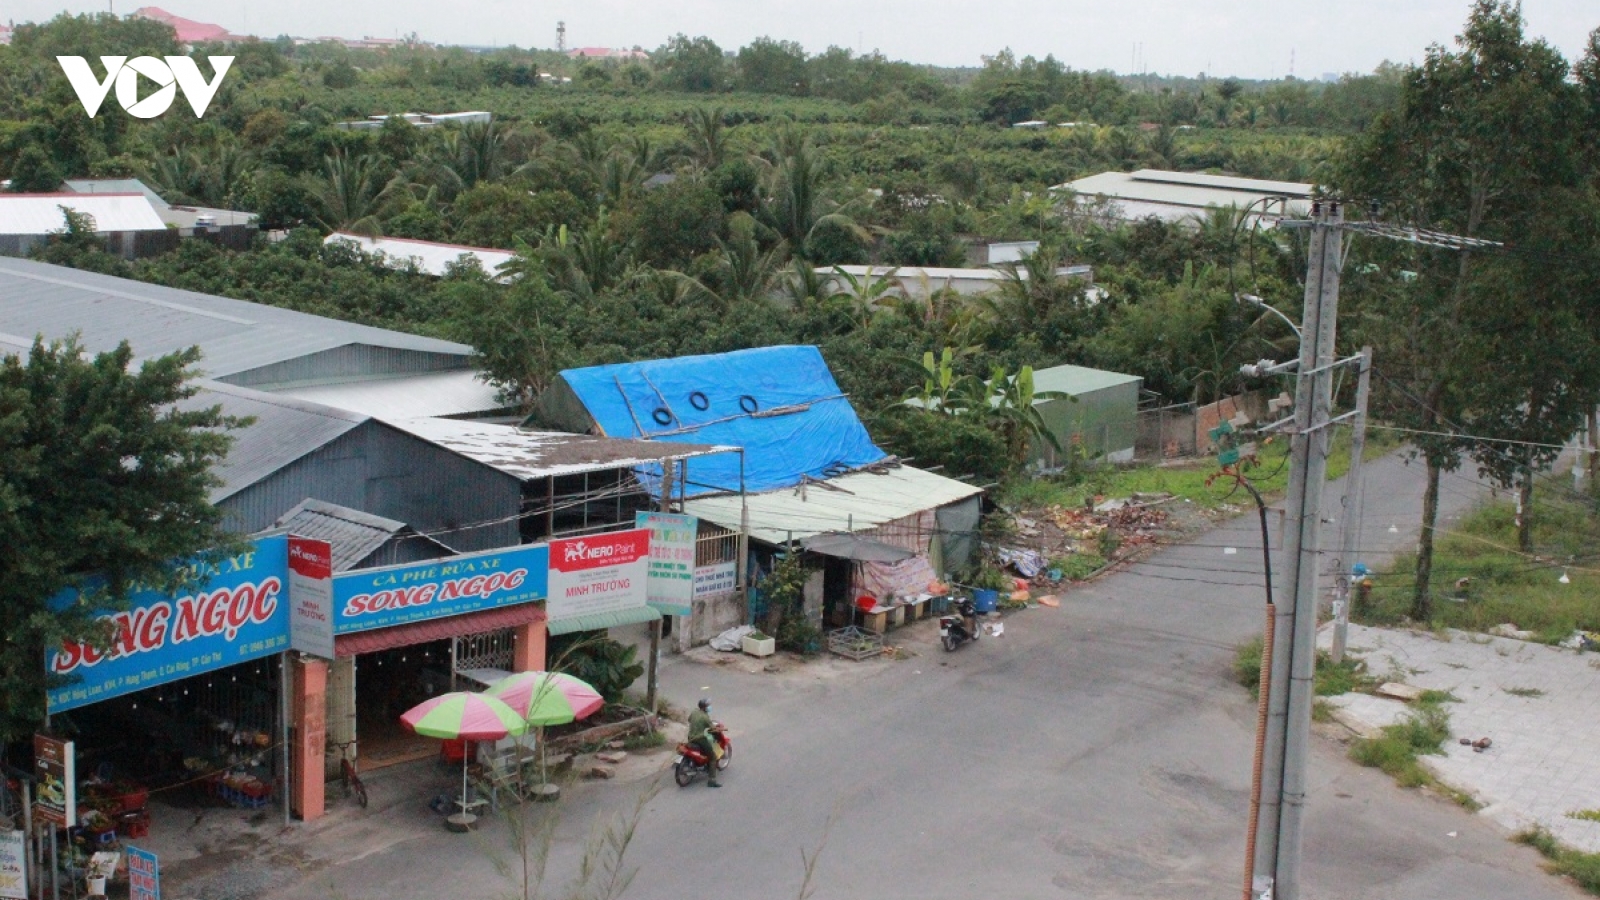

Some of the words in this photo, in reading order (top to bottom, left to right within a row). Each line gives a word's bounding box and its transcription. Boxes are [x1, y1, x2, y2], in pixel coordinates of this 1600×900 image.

[226, 551, 256, 574] XE
[588, 545, 613, 559] NERO
[614, 543, 636, 556] Paint
[402, 566, 437, 582] PHÊ
[441, 560, 476, 577] RỬA
[479, 558, 501, 571] XE
[342, 582, 438, 617] SONG
[437, 568, 528, 599] NGỌC
[565, 585, 589, 598] MINH
[171, 576, 281, 643] NGỌC
